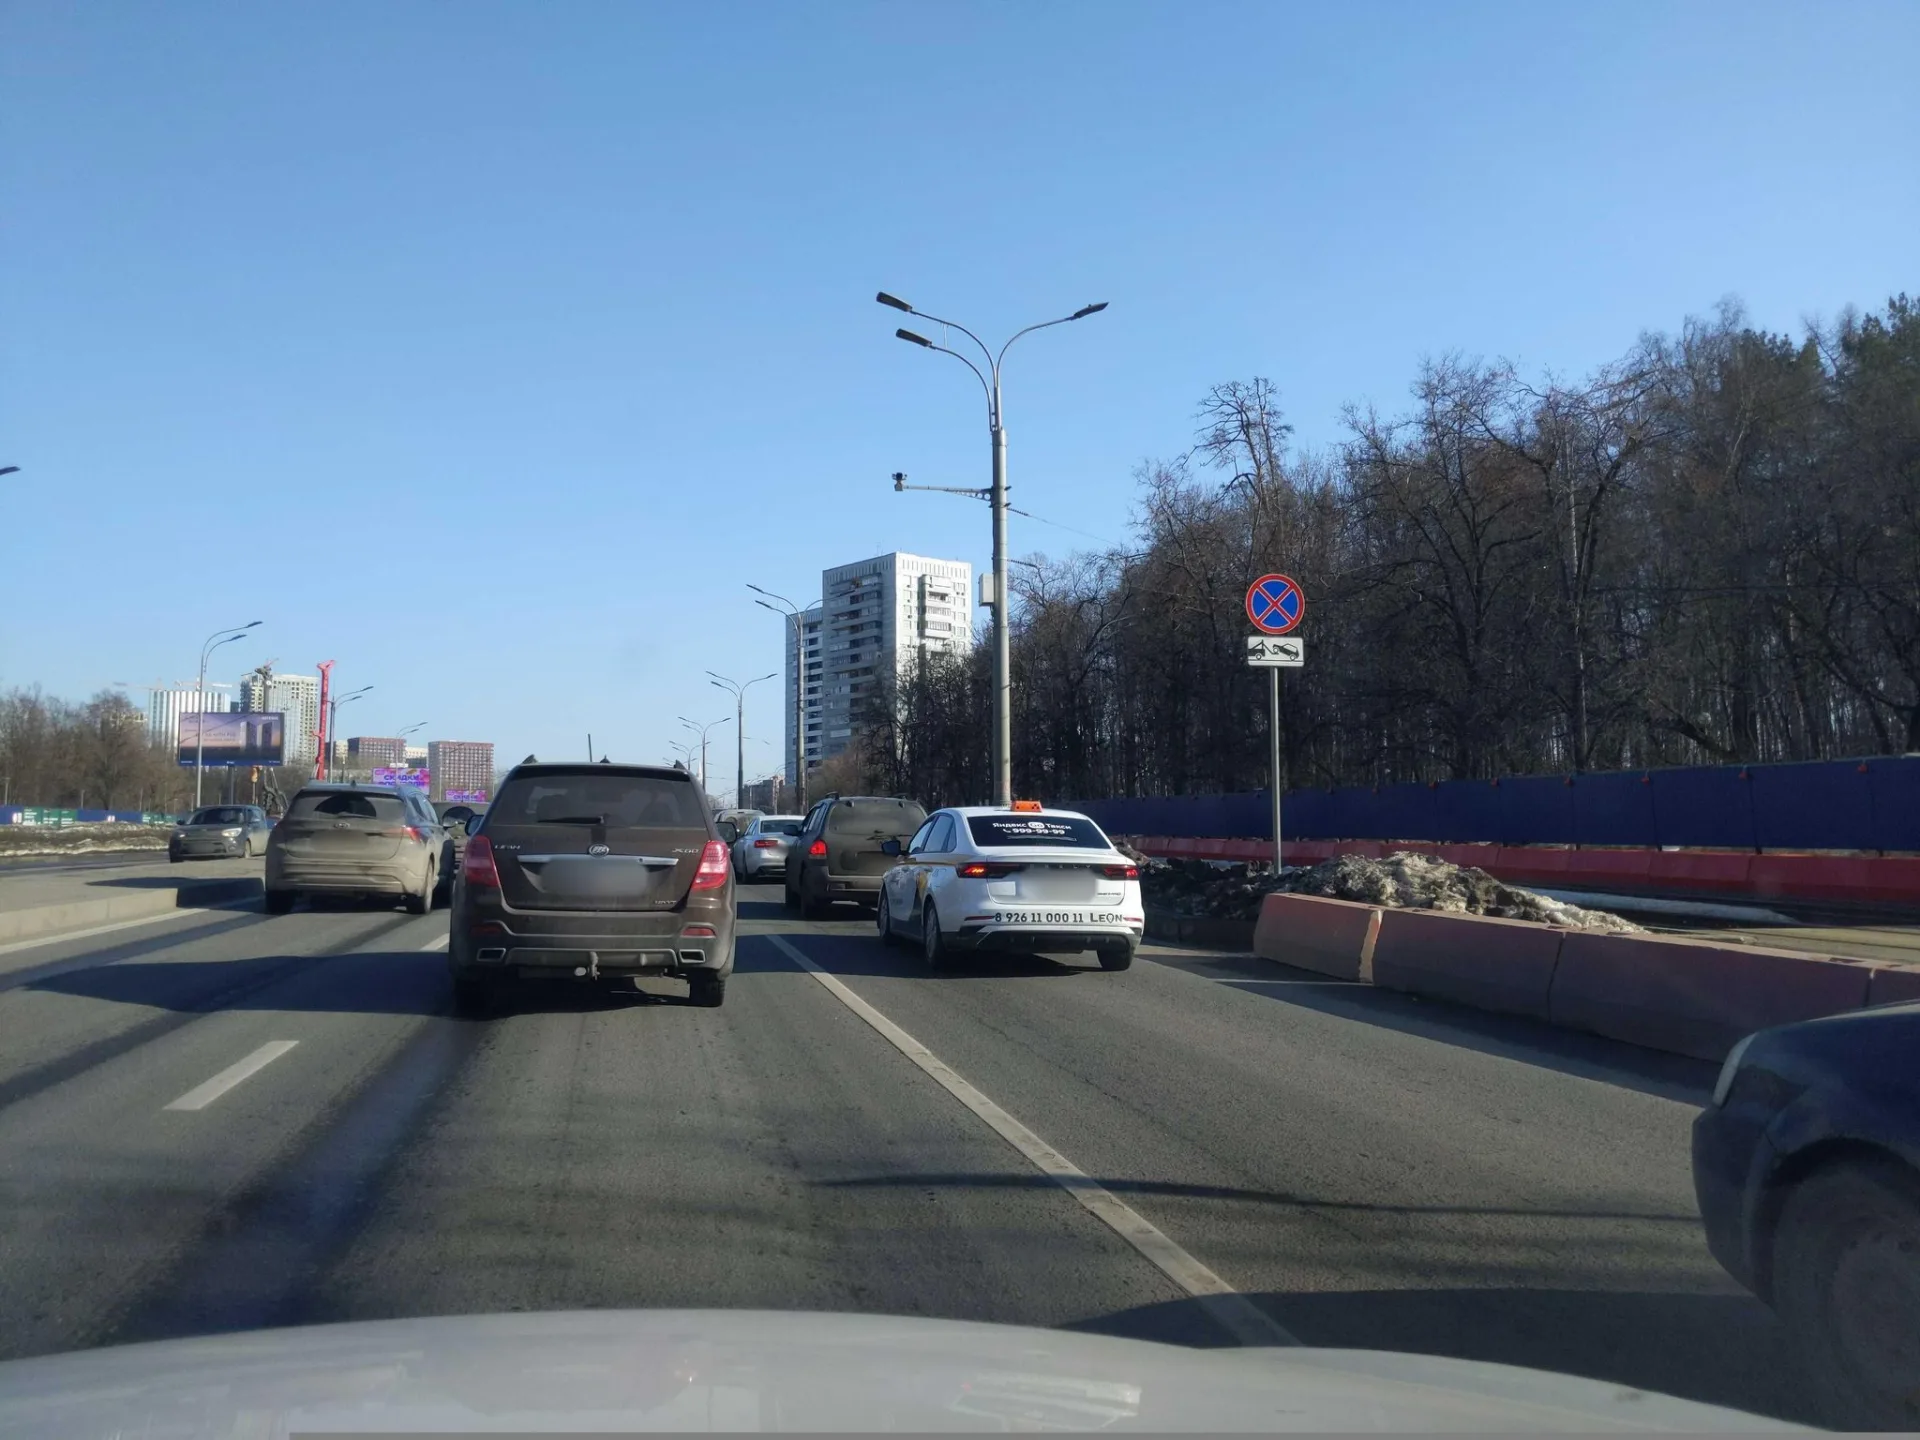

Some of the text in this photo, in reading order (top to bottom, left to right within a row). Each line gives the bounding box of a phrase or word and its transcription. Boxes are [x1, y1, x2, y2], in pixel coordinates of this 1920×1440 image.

[994, 912, 1002, 923] 8
[1005, 912, 1028, 923] 926
[1031, 912, 1042, 923] 11
[1045, 913, 1069, 923] 000
[1072, 913, 1084, 923] 11
